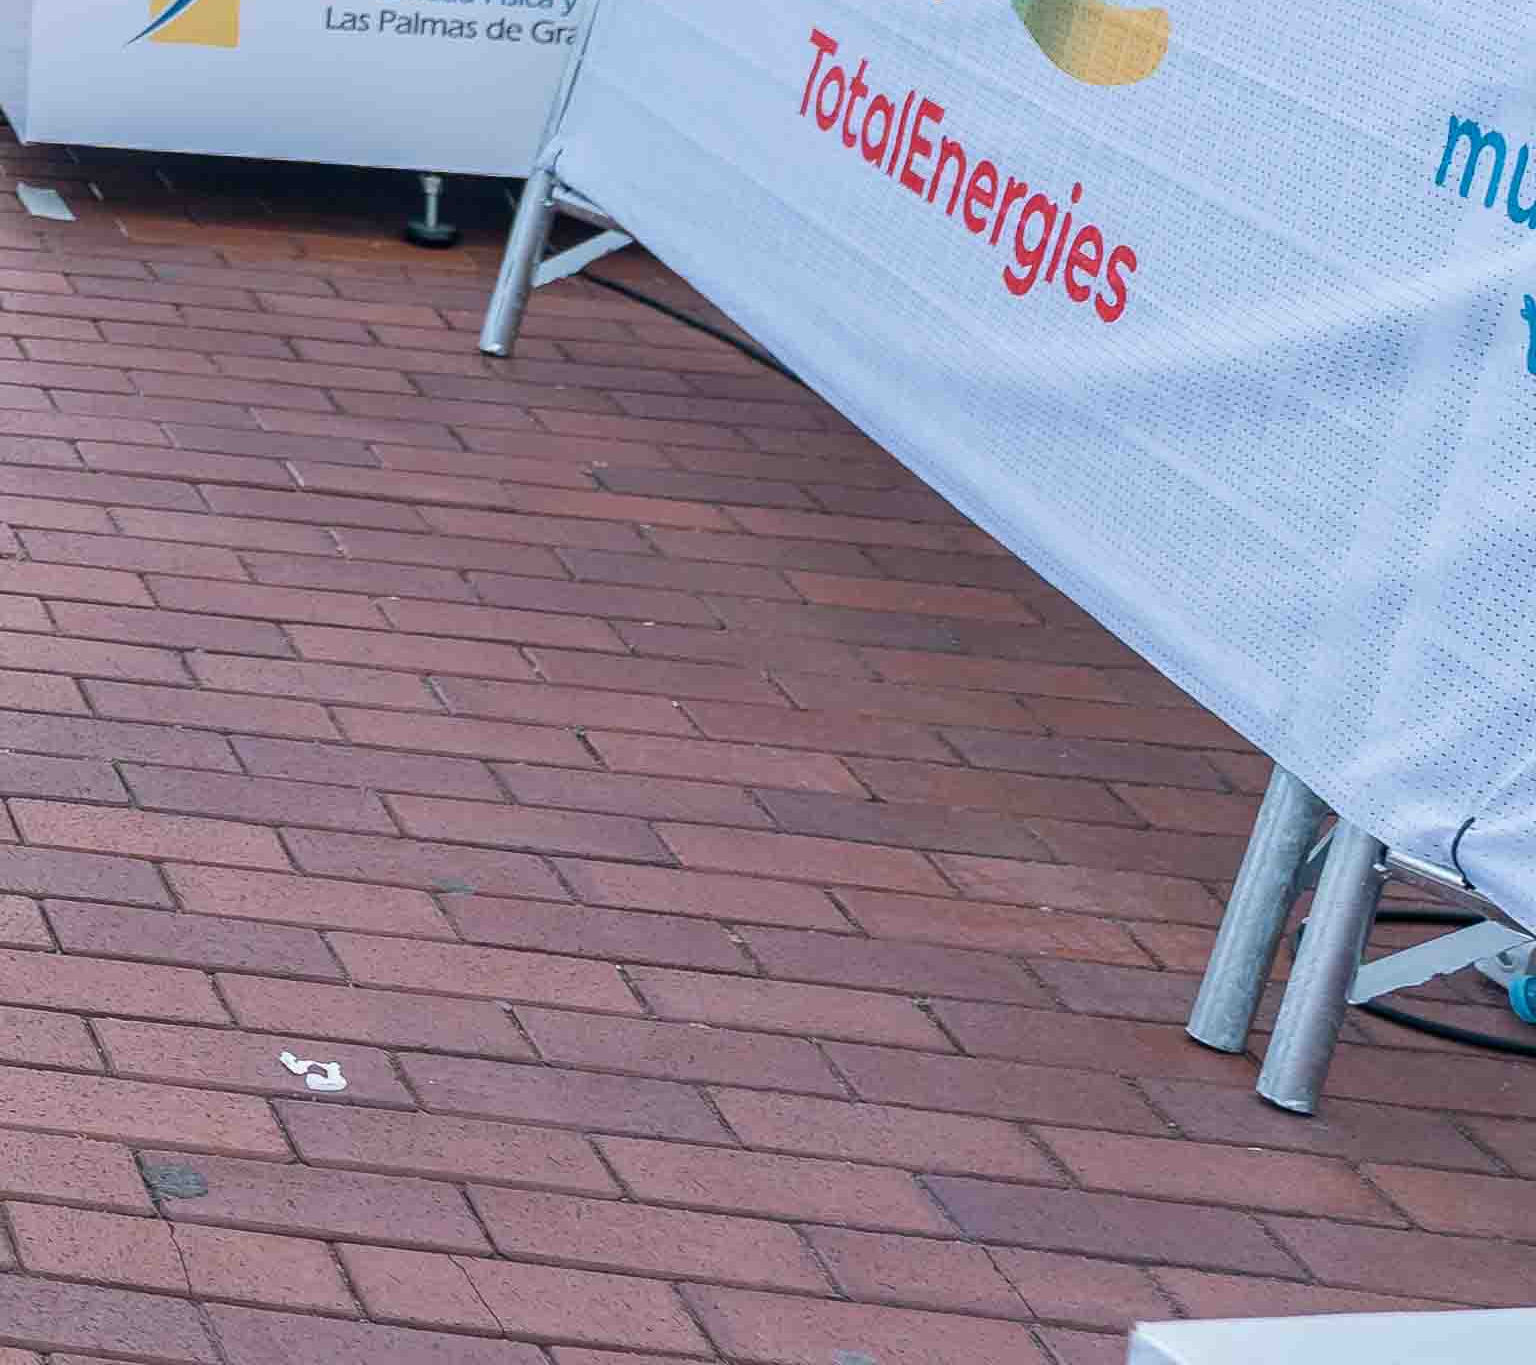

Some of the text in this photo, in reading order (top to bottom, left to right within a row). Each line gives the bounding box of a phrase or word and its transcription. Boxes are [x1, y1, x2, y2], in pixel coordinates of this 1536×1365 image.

[324, 7, 524, 43] Las Palmas de
[798, 27, 1138, 324] TotalEnergies
